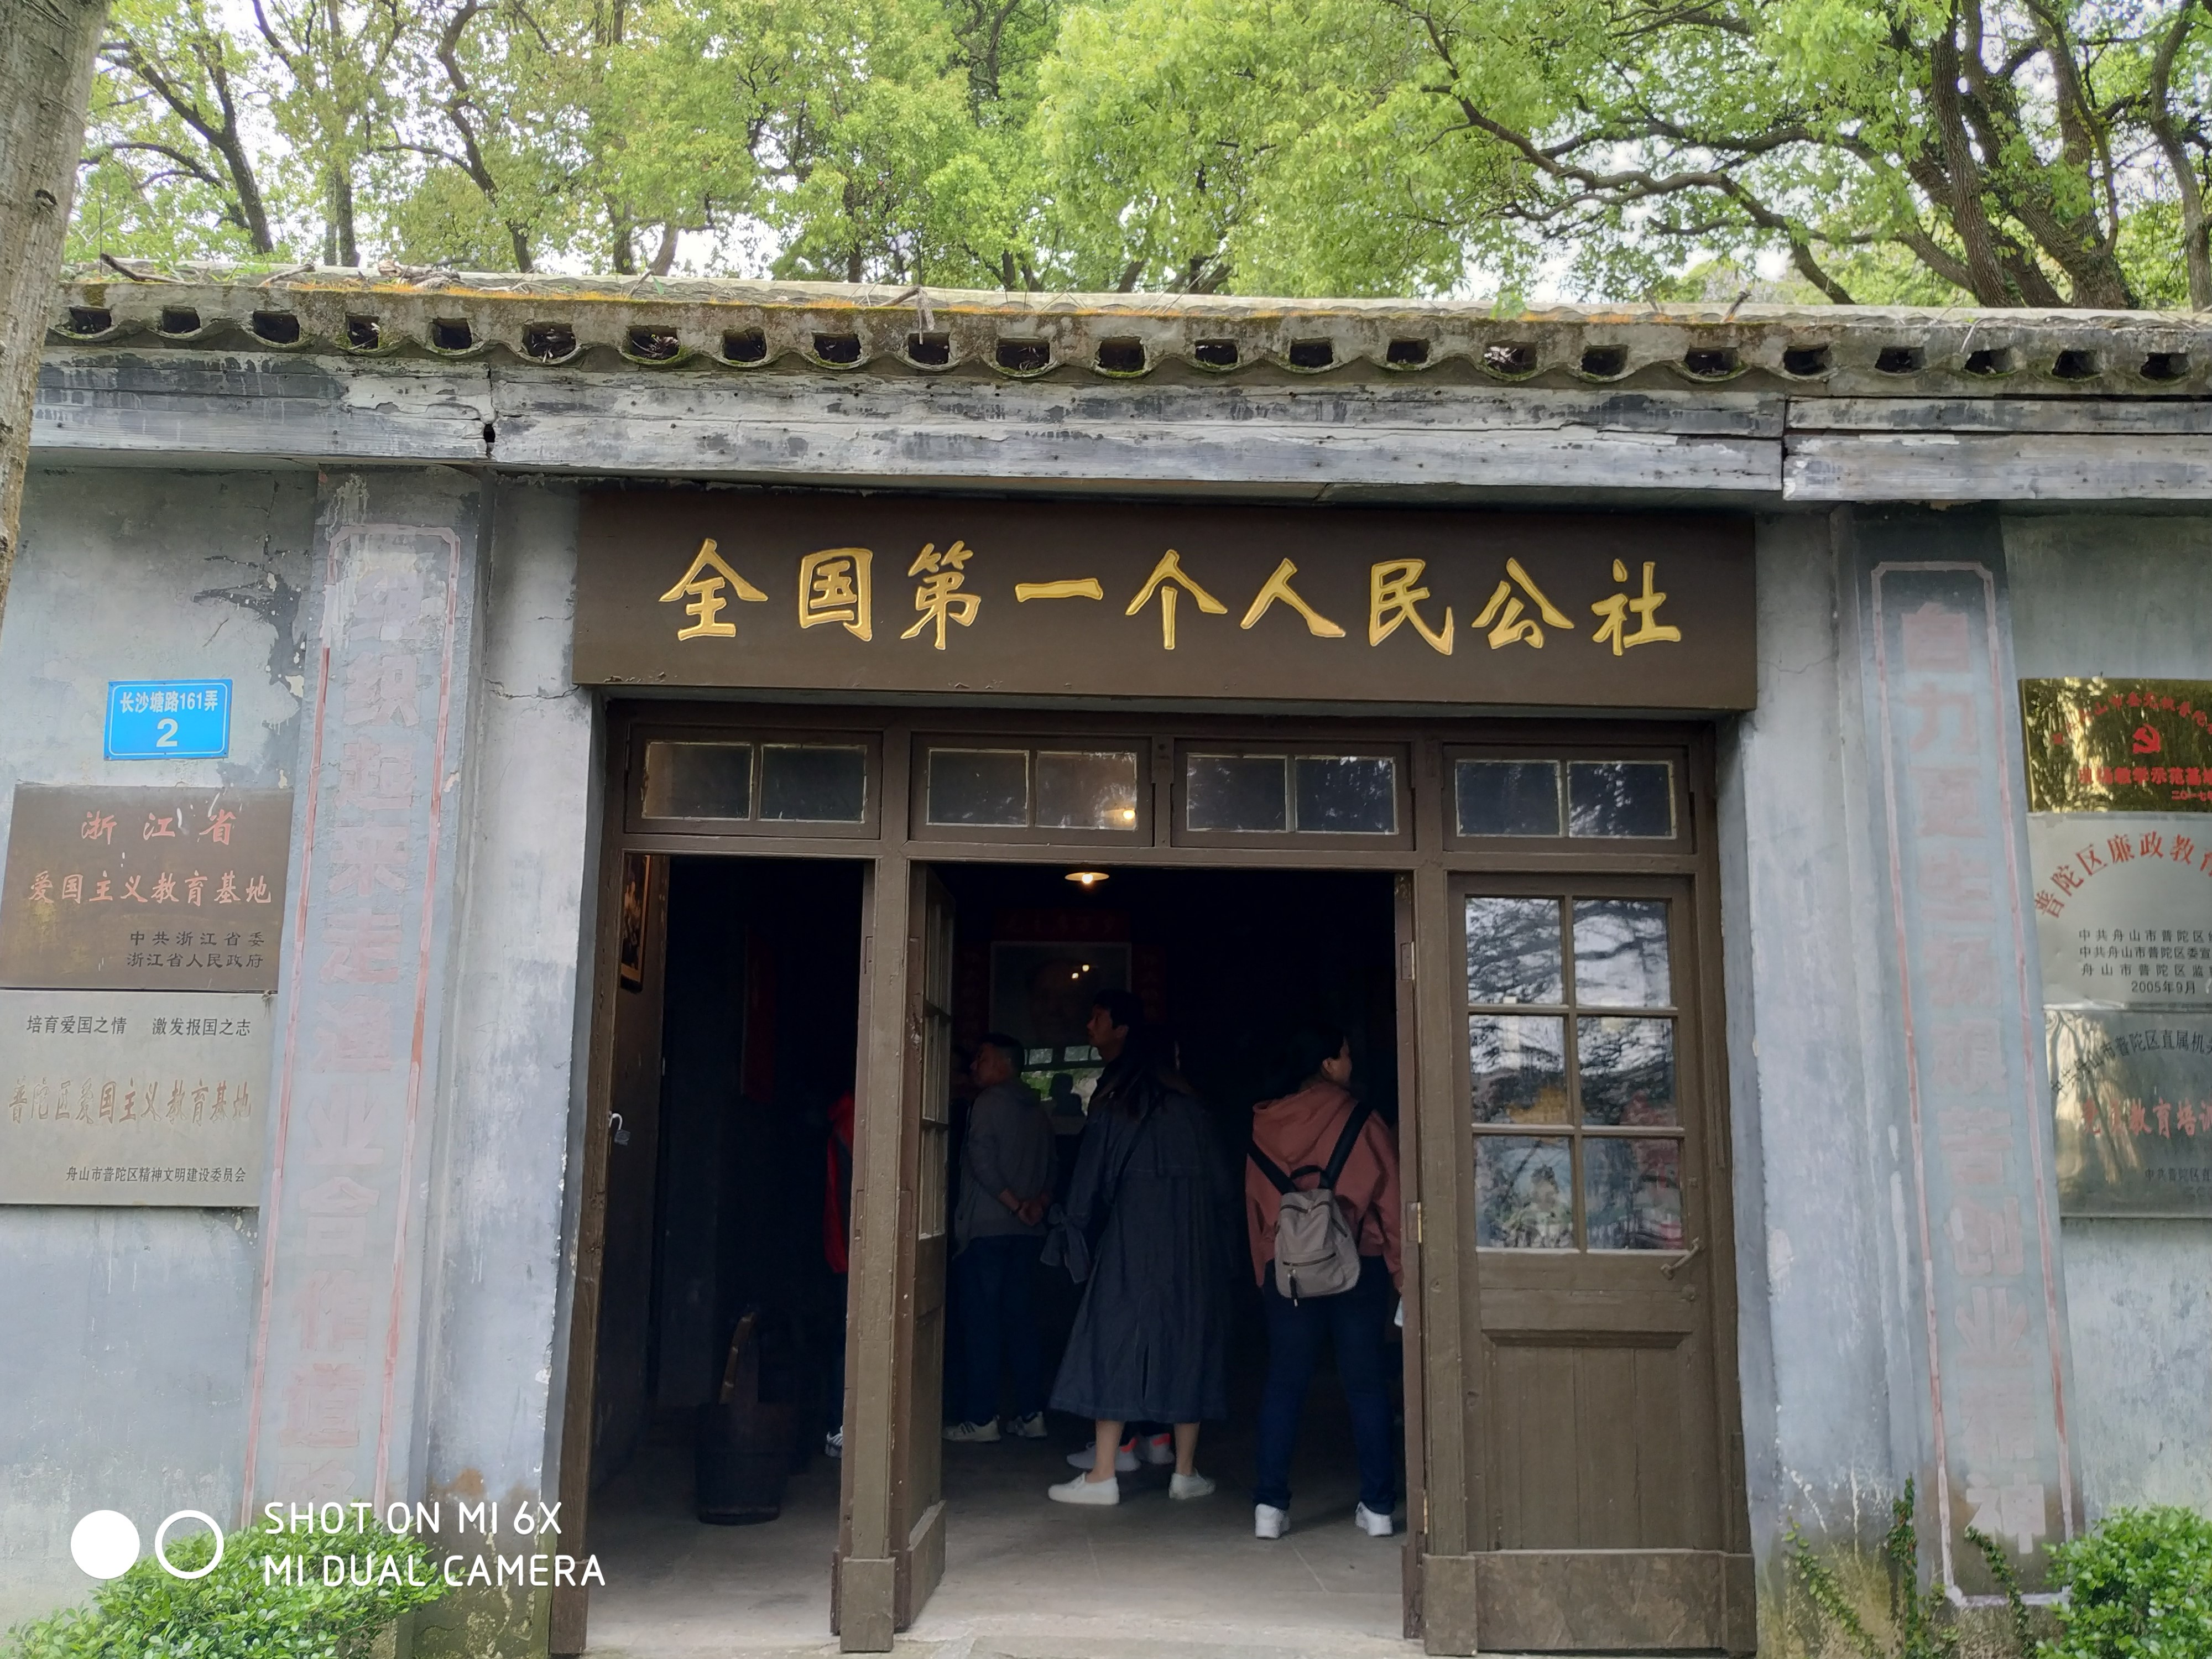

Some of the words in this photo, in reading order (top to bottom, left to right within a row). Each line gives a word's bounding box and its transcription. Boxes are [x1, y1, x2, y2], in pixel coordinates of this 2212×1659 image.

[659, 538, 1682, 656] 全国第一个人民公社
[120, 690, 218, 713] 长沙塘路161弄
[156, 718, 178, 747] 2
[81, 810, 236, 846] 浙江省
[29, 869, 272, 906] 爱国主义教育基地
[129, 931, 265, 947] 中共浙江省委
[127, 952, 264, 969] 浙江省人民政府
[2081, 963, 2212, 977] 舟山市普陀区监
[27, 1015, 127, 1035] 培育爱国之情
[152, 1017, 251, 1036] 激发报国之志
[9, 1075, 252, 1126] 普陀区爱国主义教育基地
[66, 1166, 247, 1183] 舟山市普陀区精神文明建设委员会
